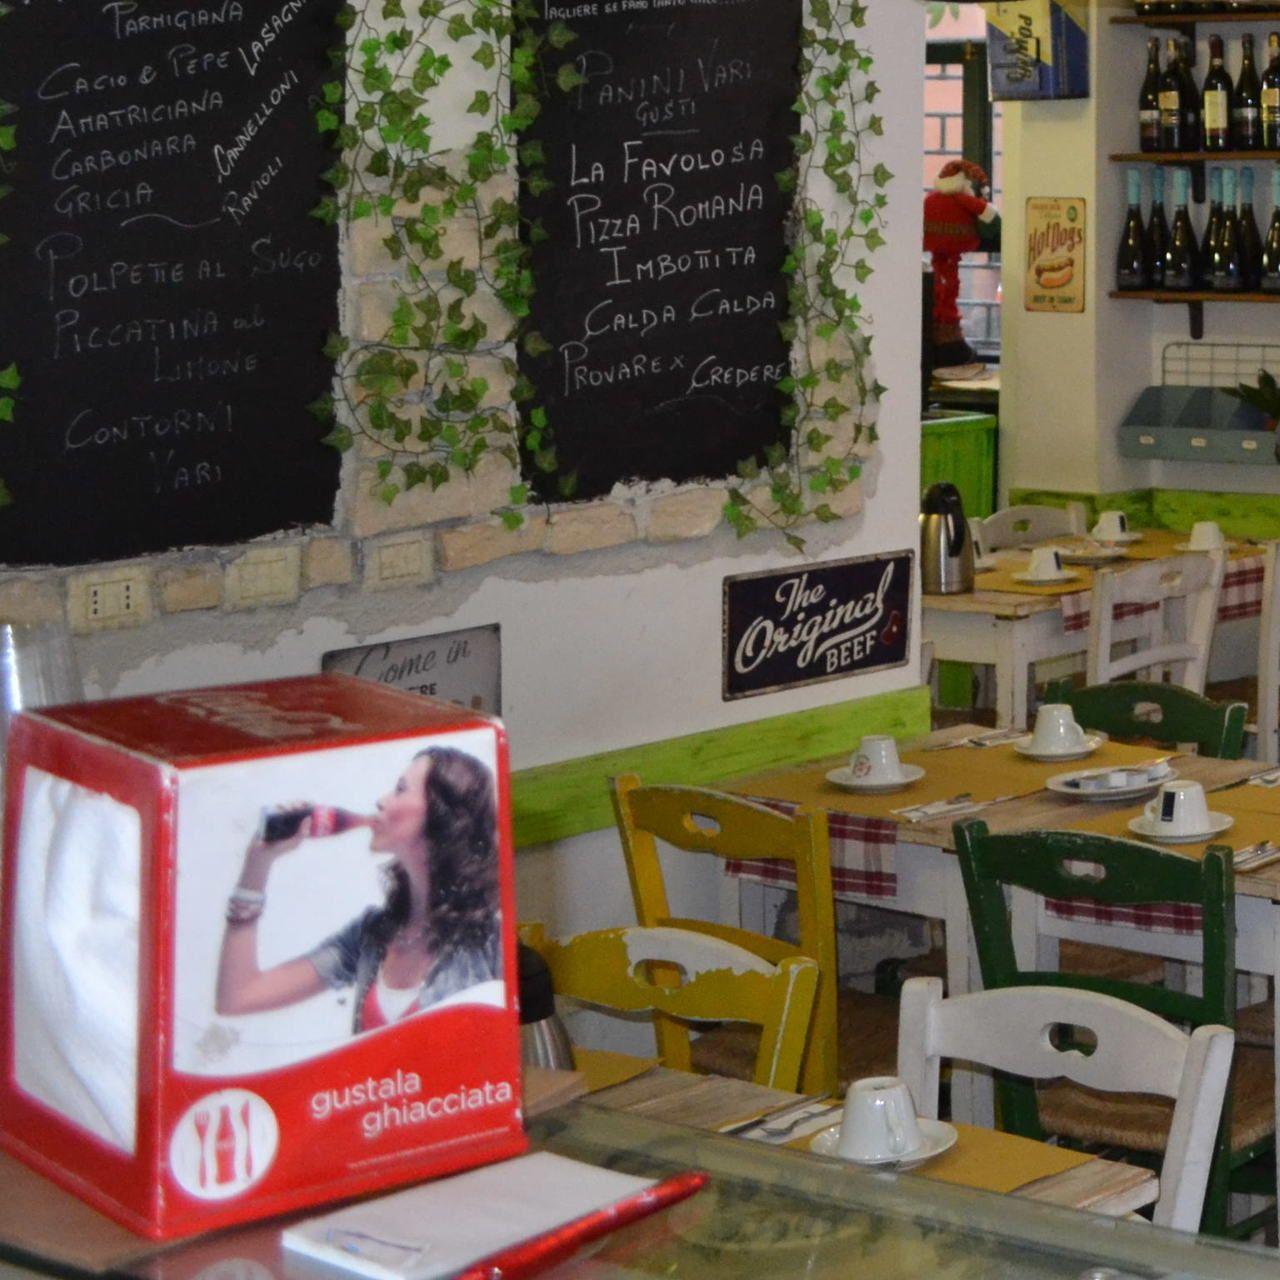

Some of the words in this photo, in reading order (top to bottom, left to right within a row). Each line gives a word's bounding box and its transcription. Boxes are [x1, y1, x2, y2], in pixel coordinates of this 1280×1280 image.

[102, 0, 243, 39] PARMIGIANA
[622, 0, 648, 12] FAMO
[38, 63, 127, 100] CACIO
[168, 43, 231, 78] PEPE
[576, 49, 684, 110] PANINI
[698, 38, 752, 93] VARI
[50, 90, 224, 143] AMATRICIANA
[214, 70, 299, 177] CANNELLONI
[635, 98, 696, 128] GUSTI
[51, 134, 197, 180] CARBONARA
[569, 144, 604, 187] LA
[624, 139, 765, 183] FAVOLOSA
[54, 183, 154, 219] GRICIA
[222, 156, 283, 226] RAVIOLI
[567, 193, 640, 248] PIZZA
[643, 182, 764, 231] ROMANA
[36, 232, 185, 301] POLPETTE
[198, 259, 226, 280] AL
[249, 233, 322, 277] SUGO
[599, 245, 756, 287] IMBOTTITA
[54, 309, 219, 360] PICCATINA
[581, 299, 676, 342] CALDA
[689, 289, 776, 322] CALDA
[153, 346, 258, 383] LIMONE
[559, 341, 661, 398] PROVARE
[686, 355, 787, 395] CREDERE
[64, 404, 233, 452] CONTORNI
[734, 561, 895, 674] Original
[775, 573, 826, 620] The
[446, 639, 471, 664] in
[826, 630, 878, 673] BEEF
[311, 1068, 421, 1119] gustala
[362, 1081, 512, 1139] ghiacciata
